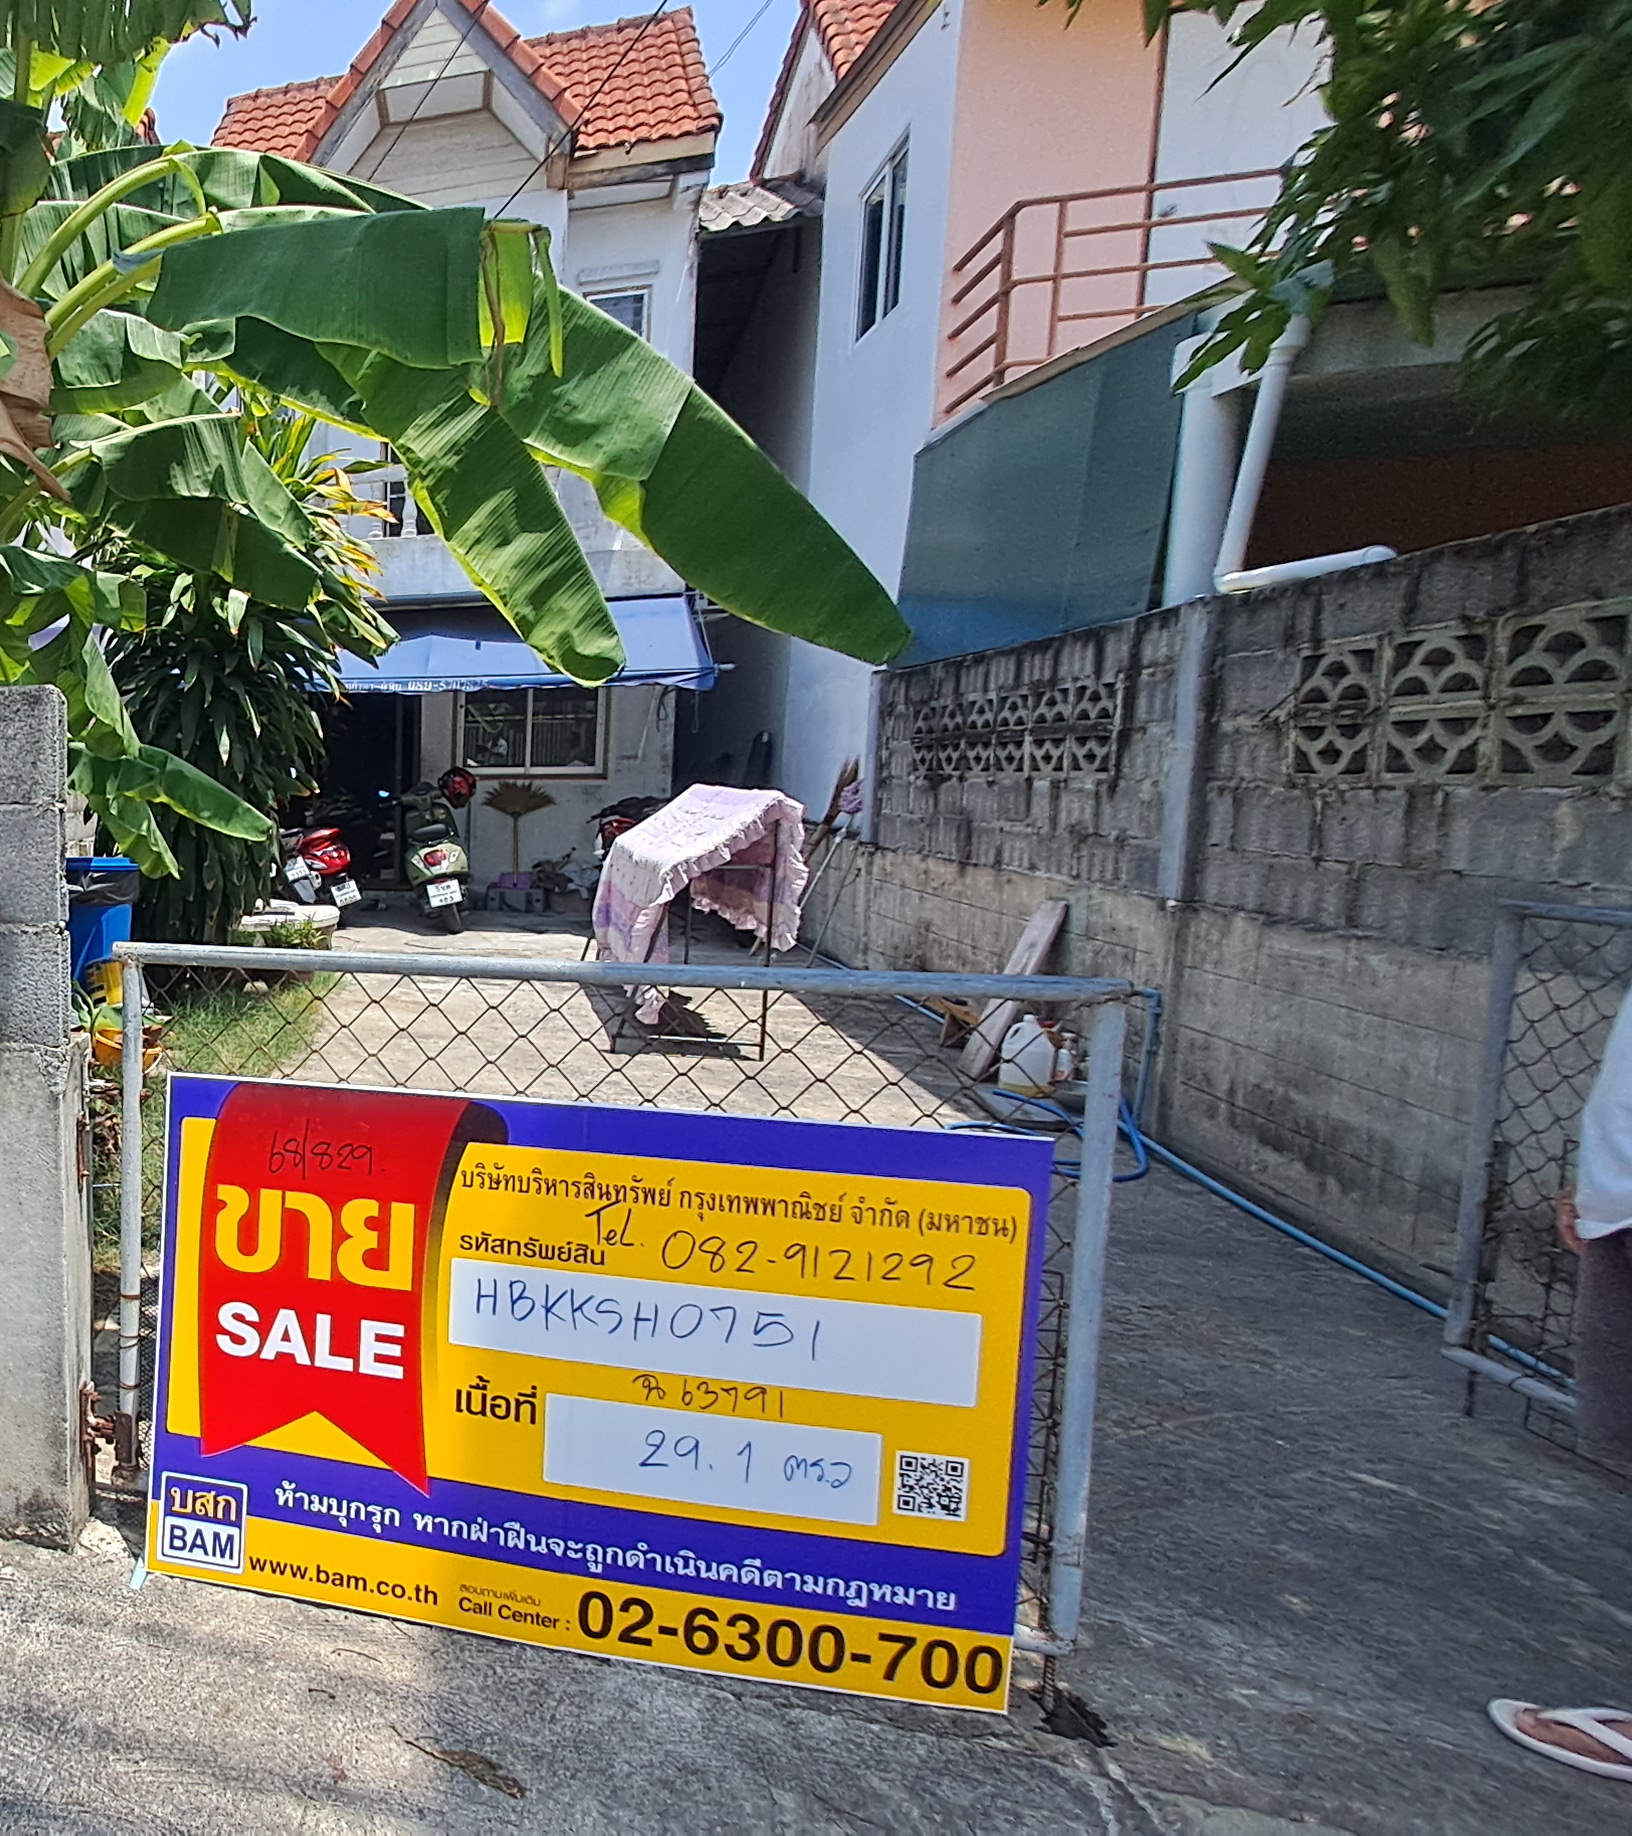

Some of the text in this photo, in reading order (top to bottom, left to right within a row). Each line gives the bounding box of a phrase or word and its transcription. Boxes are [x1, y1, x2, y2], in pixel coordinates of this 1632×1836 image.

[461, 1162, 1018, 1245] บริษัทบริหารสินทรัพย์ กรุงเทพพาณิชย์ จำกัด (มหาชน)
[215, 1183, 415, 1292] ขาย
[459, 1231, 606, 1267] รหัสทรัพย์สิน
[661, 1230, 976, 1291] 082-9121292
[215, 1301, 406, 1380] SALE
[455, 1375, 538, 1425] เนื้อที่
[681, 1377, 785, 1418] 63791
[169, 1485, 238, 1523] บสก
[274, 1480, 401, 1534] ห้ามบุกรุก
[168, 1524, 236, 1562] BAM
[249, 1554, 440, 1607] www.bam.co.th
[458, 1596, 493, 1618] Call
[497, 1603, 561, 1631] Center
[577, 1590, 1004, 1695] 02-6300-700
